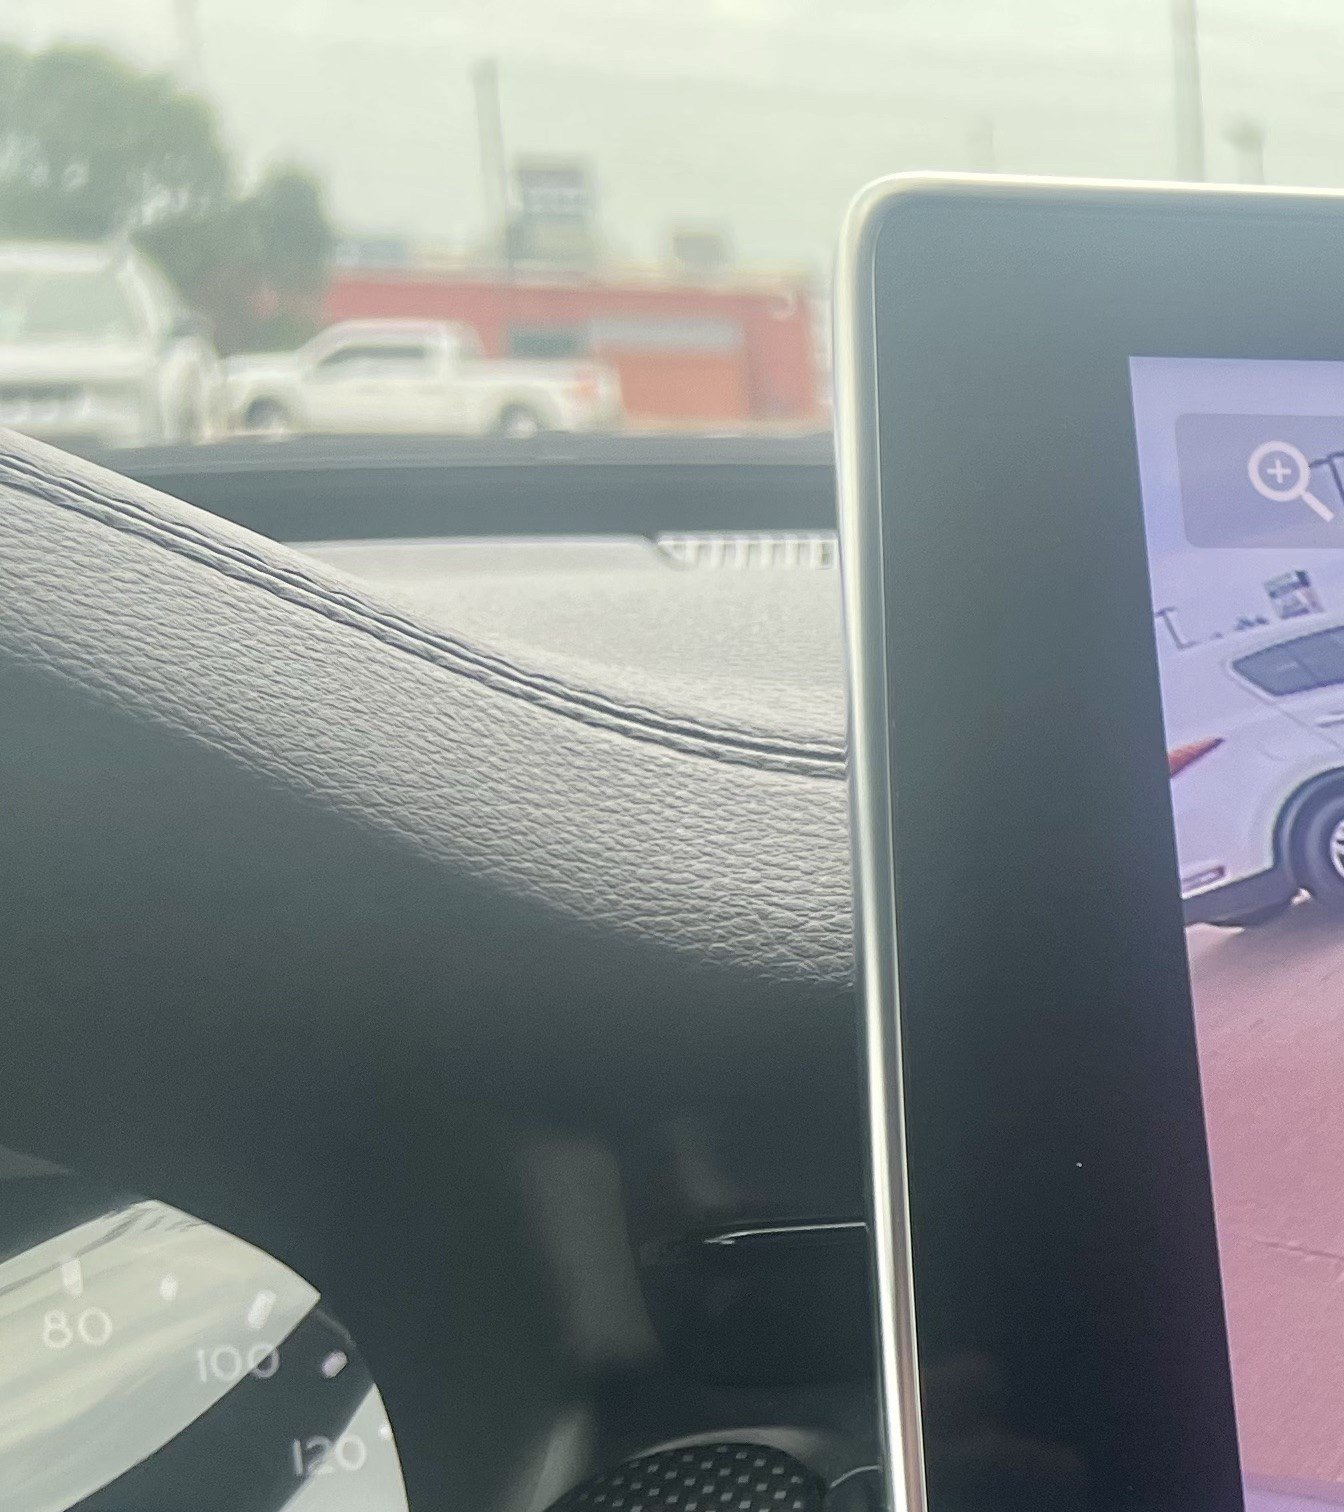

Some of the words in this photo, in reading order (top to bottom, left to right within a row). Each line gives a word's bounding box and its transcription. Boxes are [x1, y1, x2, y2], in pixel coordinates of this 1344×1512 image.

[42, 1306, 113, 1350] 80
[196, 1341, 281, 1384] 100
[291, 1433, 367, 1476] 120
